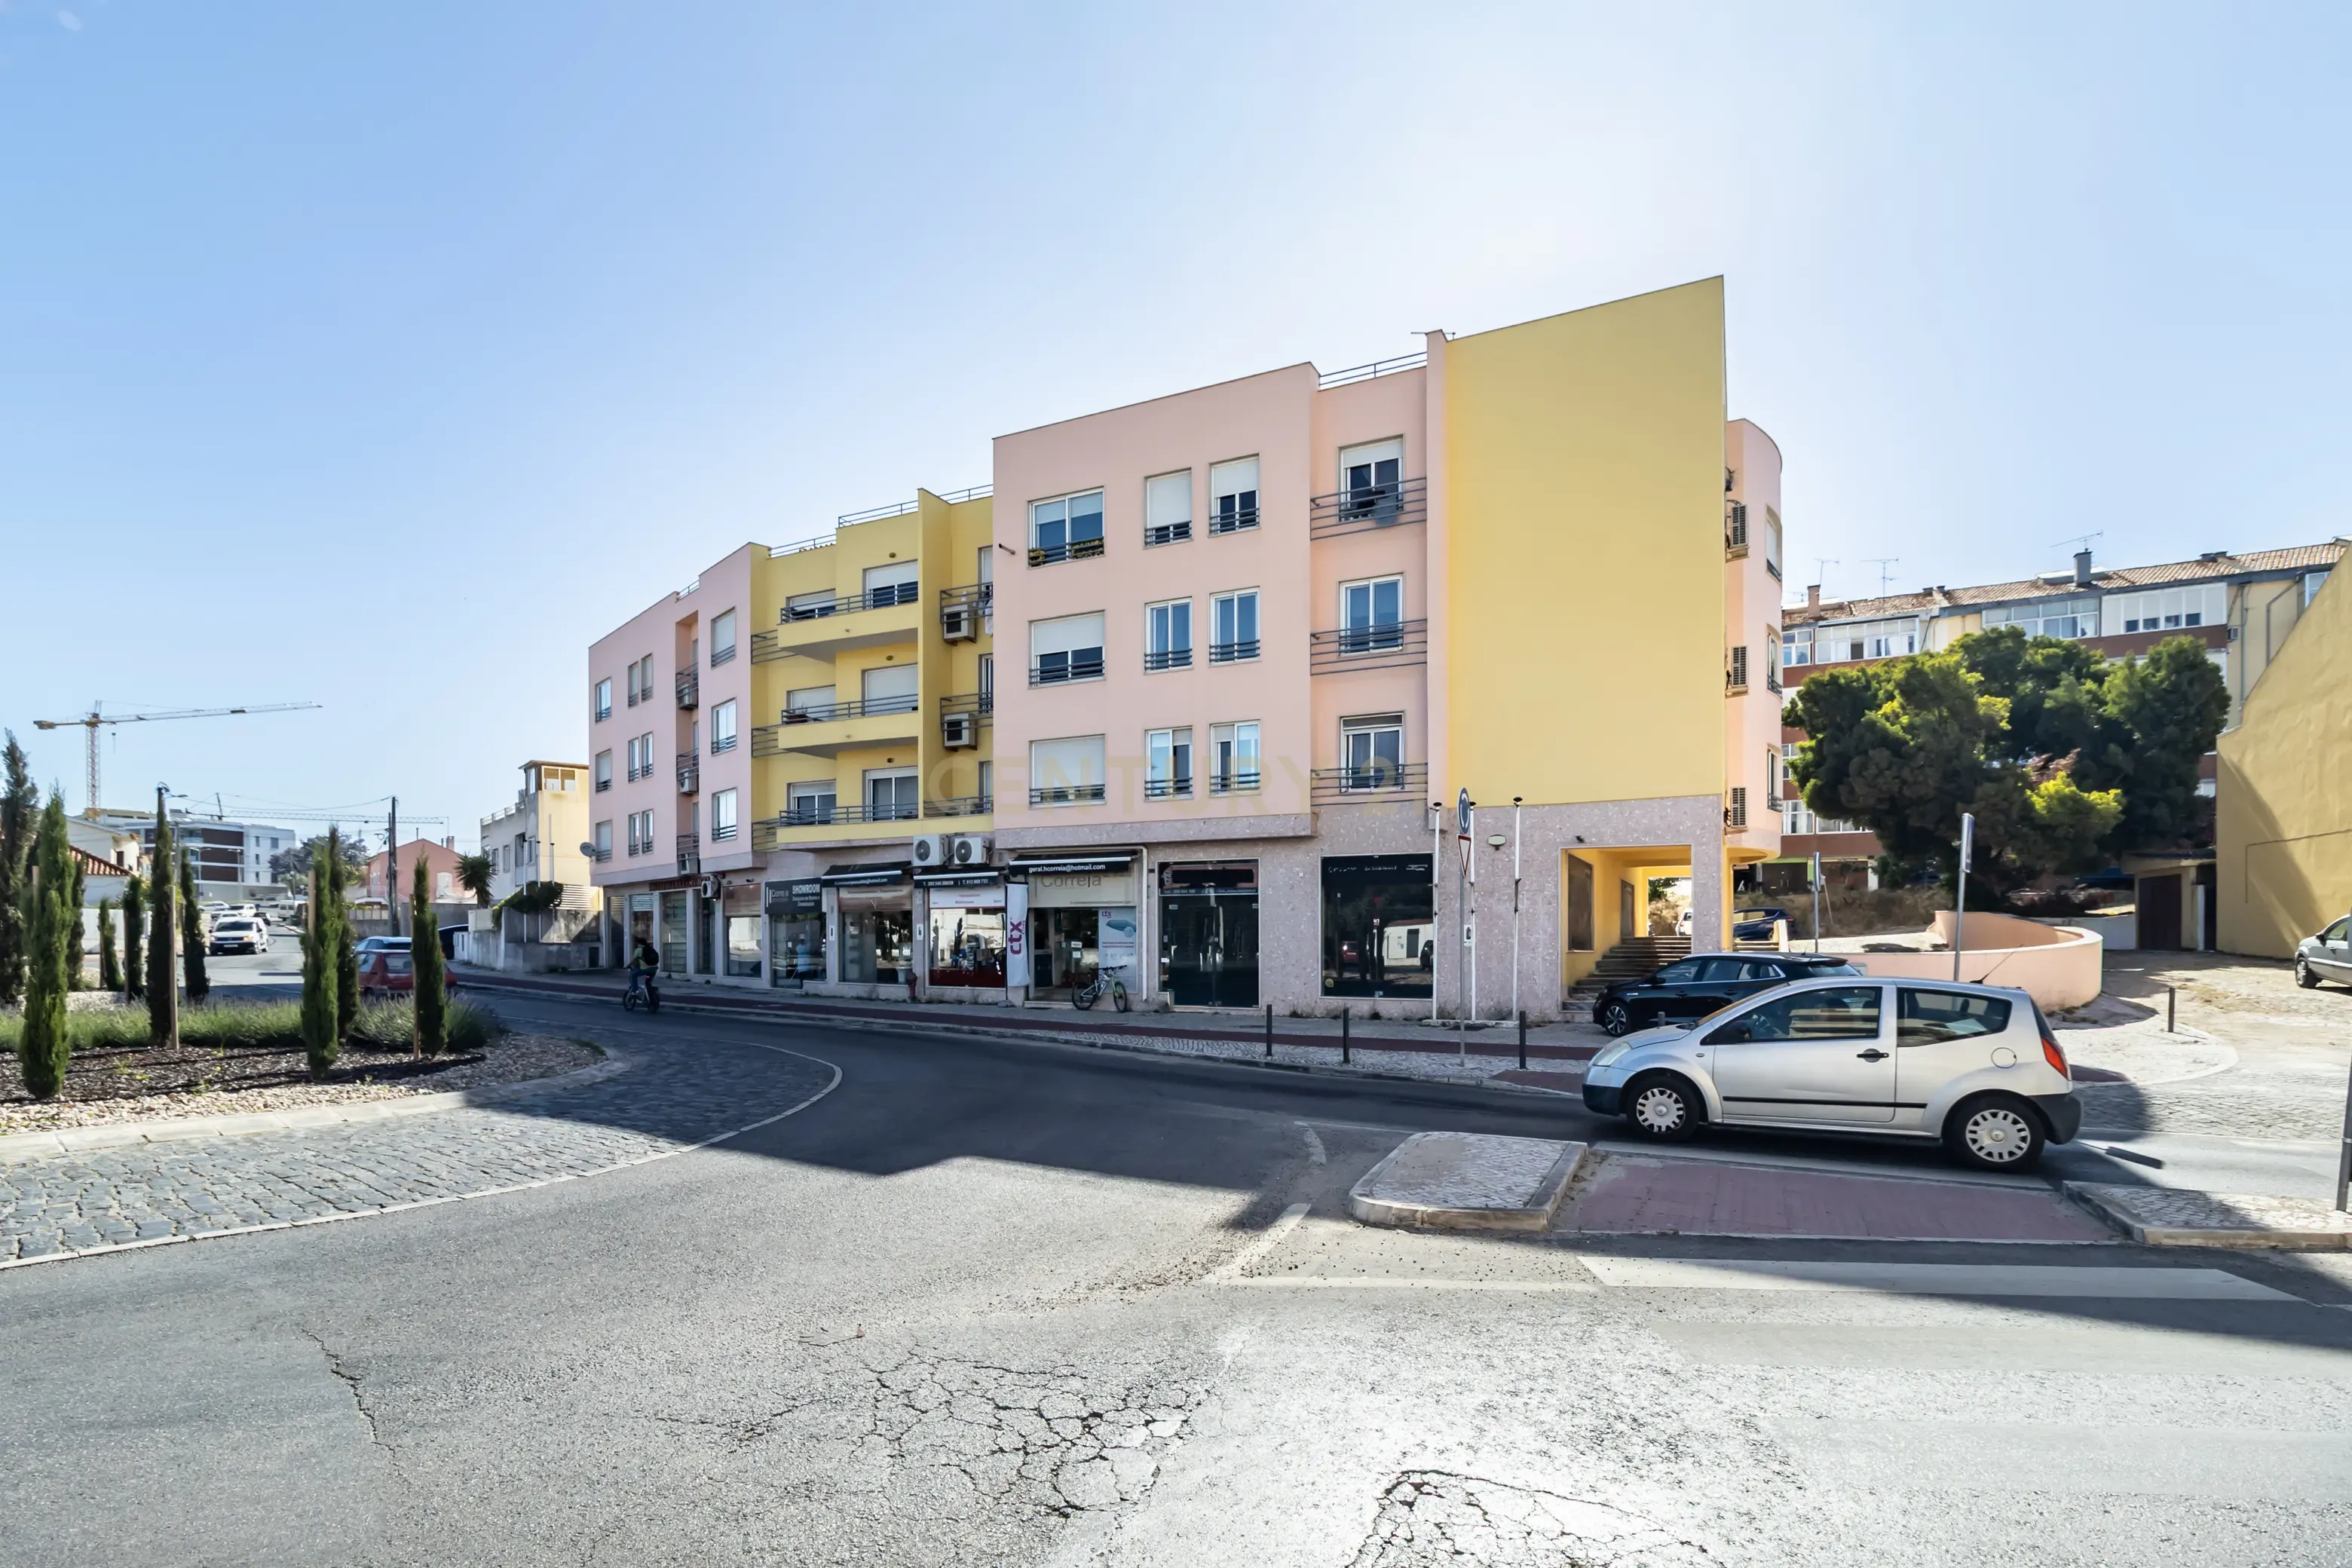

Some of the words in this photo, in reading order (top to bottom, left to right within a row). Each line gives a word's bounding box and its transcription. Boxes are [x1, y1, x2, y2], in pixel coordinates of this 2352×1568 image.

[1028, 864, 1106, 874] geral.hcorreia@hotmail.com
[792, 884, 820, 895] SHOWROOM
[1008, 920, 1022, 954] ctx
